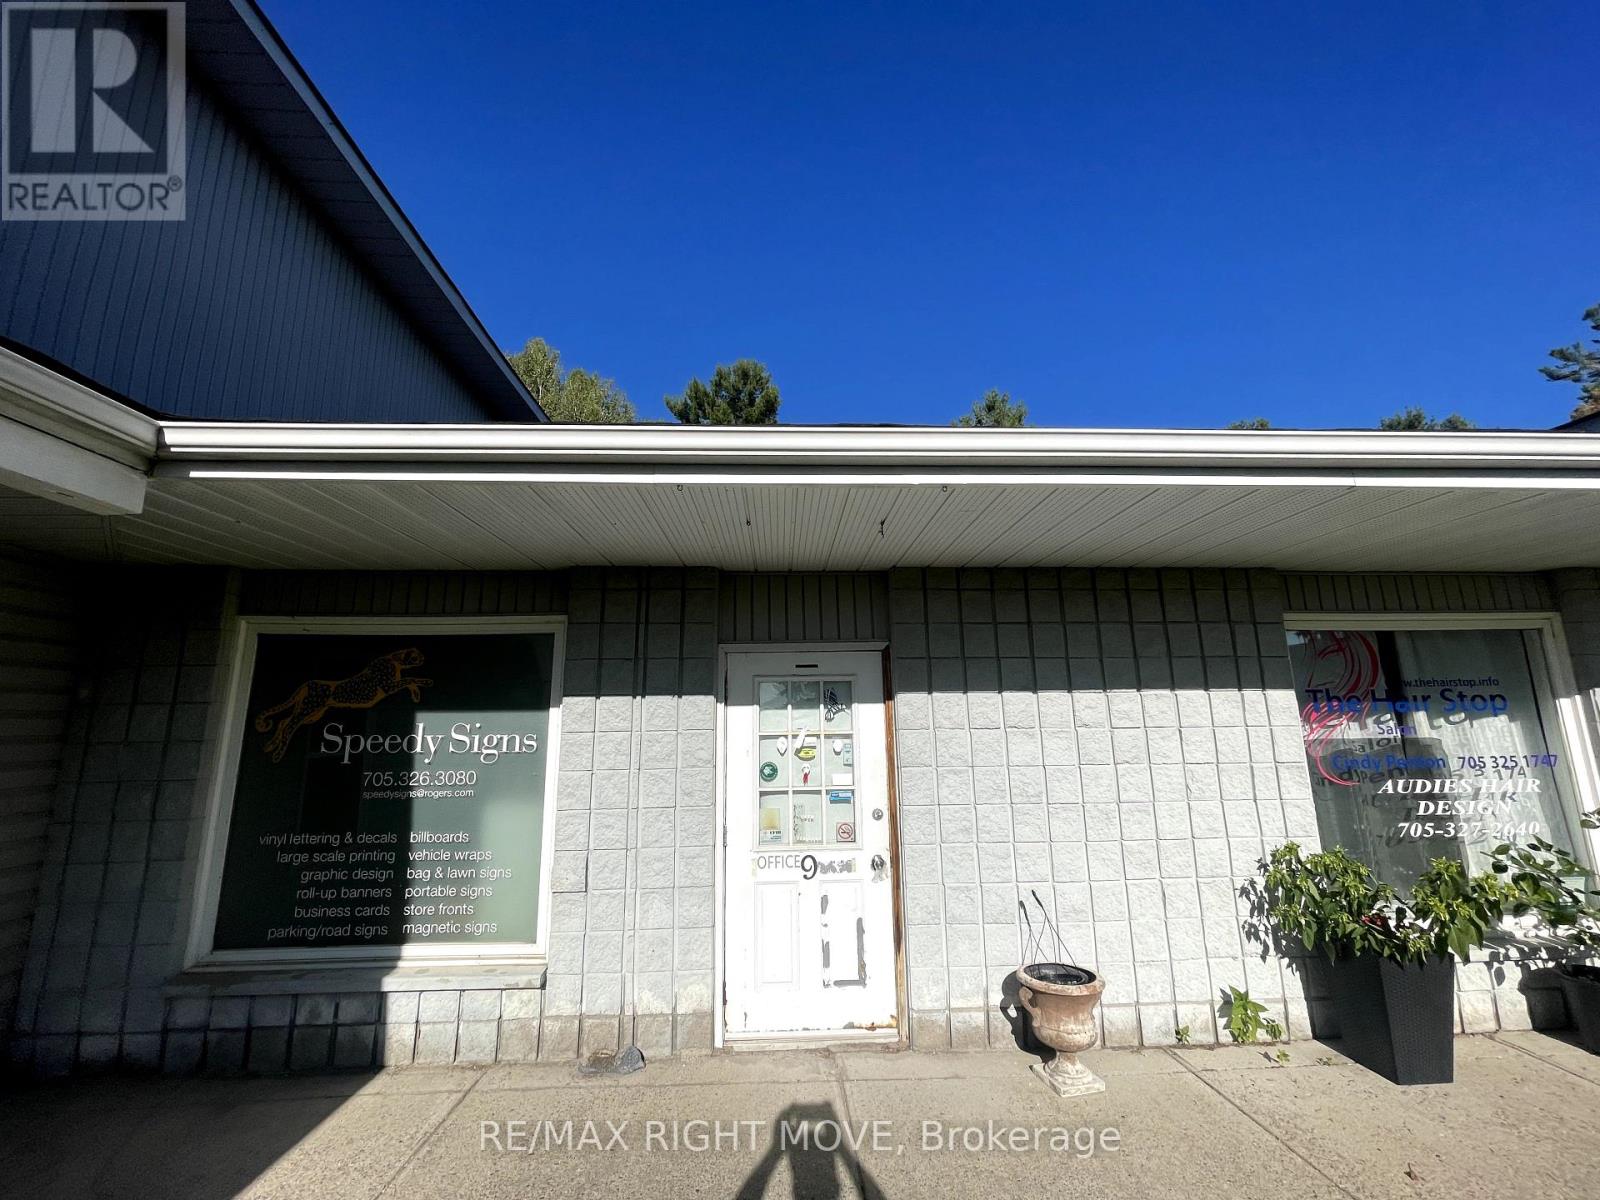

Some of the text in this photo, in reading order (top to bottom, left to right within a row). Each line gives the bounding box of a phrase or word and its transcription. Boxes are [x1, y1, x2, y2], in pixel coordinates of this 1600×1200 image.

[1398, 676, 1500, 688] w.thehairstop.info
[1305, 687, 1508, 717] The Hair Stop
[321, 722, 538, 764] Speedy Signs
[1331, 754, 1380, 773] Cindy
[1457, 754, 1558, 769] 705 325 1747
[363, 770, 477, 786] 705.326.3080
[1377, 778, 1542, 794] AUDIES HAIR
[362, 788, 474, 799] speedysigns@rogers.com
[1416, 800, 1513, 816] DESIGN
[410, 831, 469, 843] billboards
[1397, 821, 1541, 839] 705-327-2640
[259, 831, 398, 848] vinyl lettering & decals
[277, 849, 396, 866] large scale printing
[408, 849, 493, 863] vehicle wraps
[406, 866, 512, 882] bag & lawn signs
[757, 854, 818, 880] OFFICE 9
[300, 867, 394, 884] graphic design
[296, 886, 392, 901] roll-up banners
[404, 884, 493, 900] portable signs
[294, 904, 391, 919] business cards
[403, 902, 474, 916] store fronts
[267, 923, 389, 940] parking/road signs
[402, 920, 498, 937] magnetic signs
